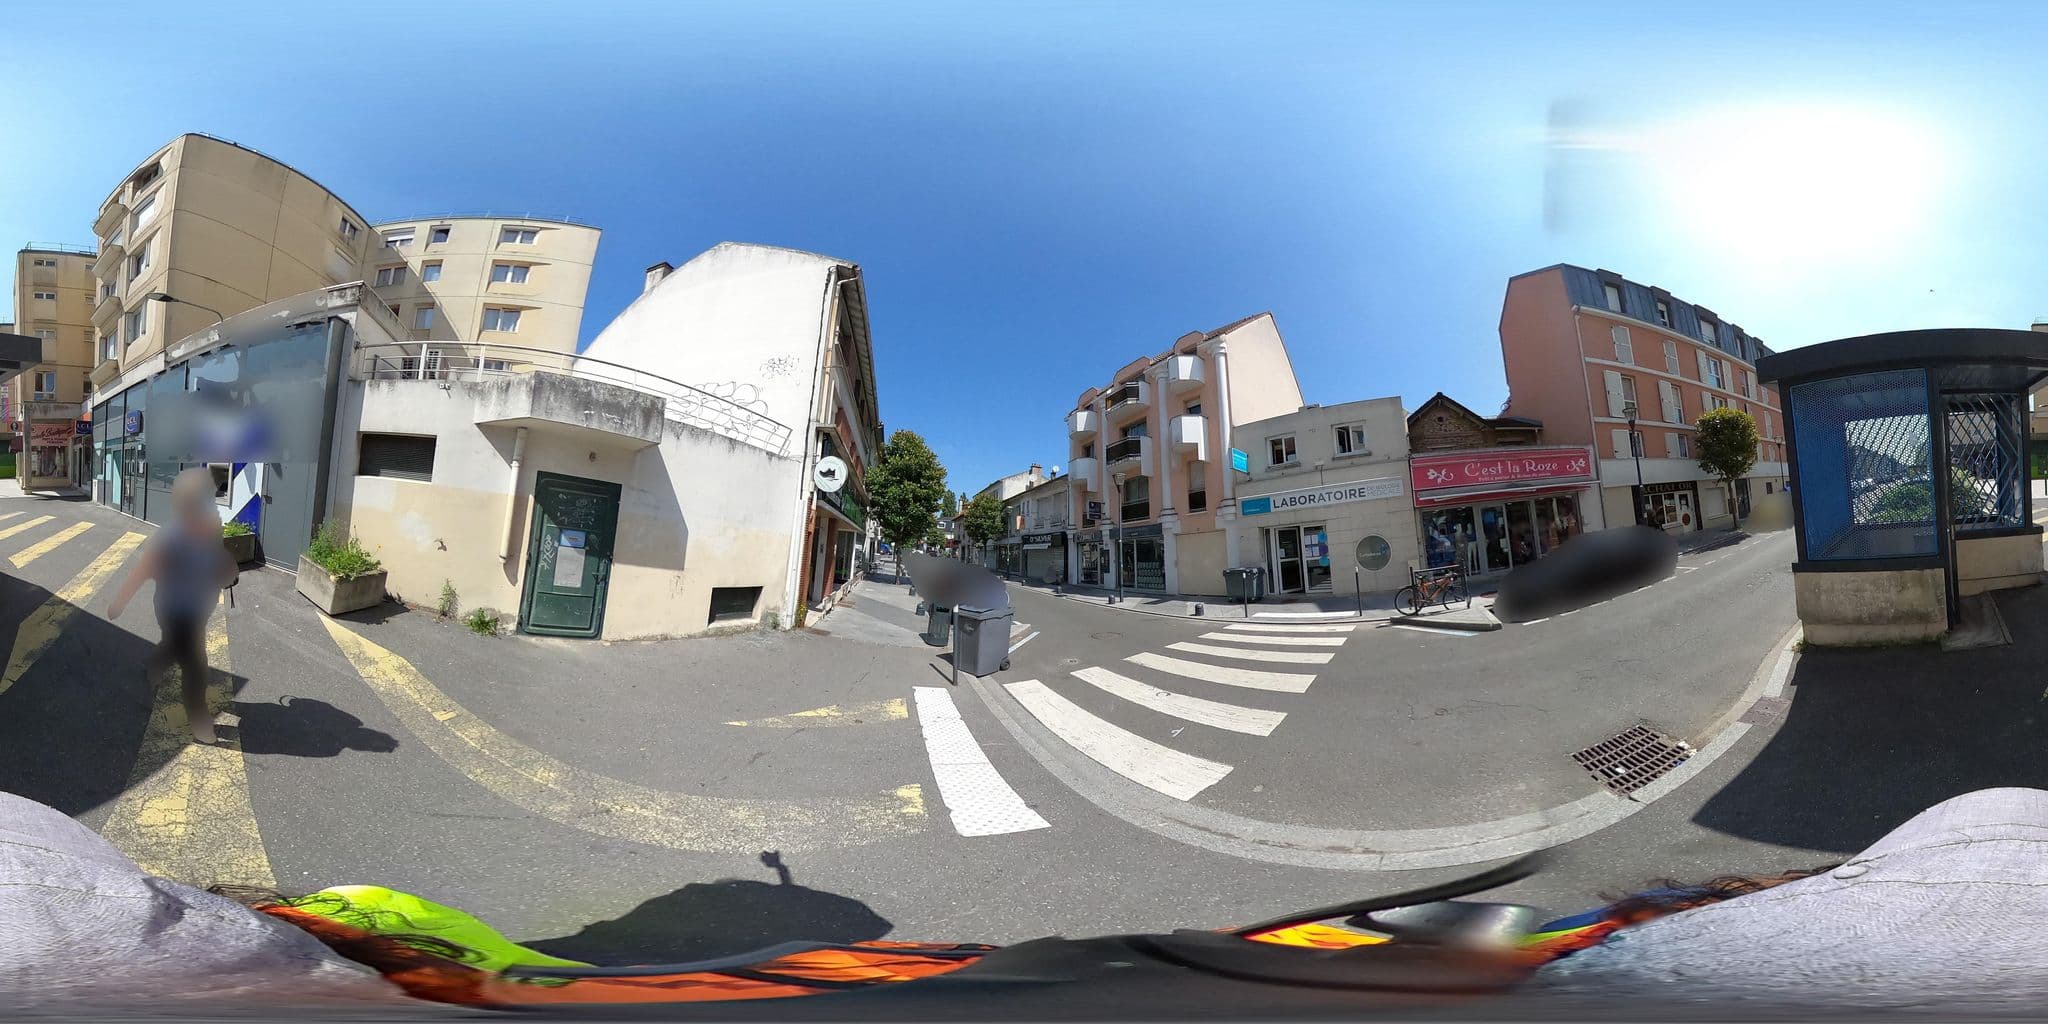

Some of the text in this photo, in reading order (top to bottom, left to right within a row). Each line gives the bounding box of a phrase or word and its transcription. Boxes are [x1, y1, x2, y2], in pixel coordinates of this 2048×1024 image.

[1464, 459, 1559, 477] C'est la Roze
[1273, 487, 1367, 509] LABORATOIRE
